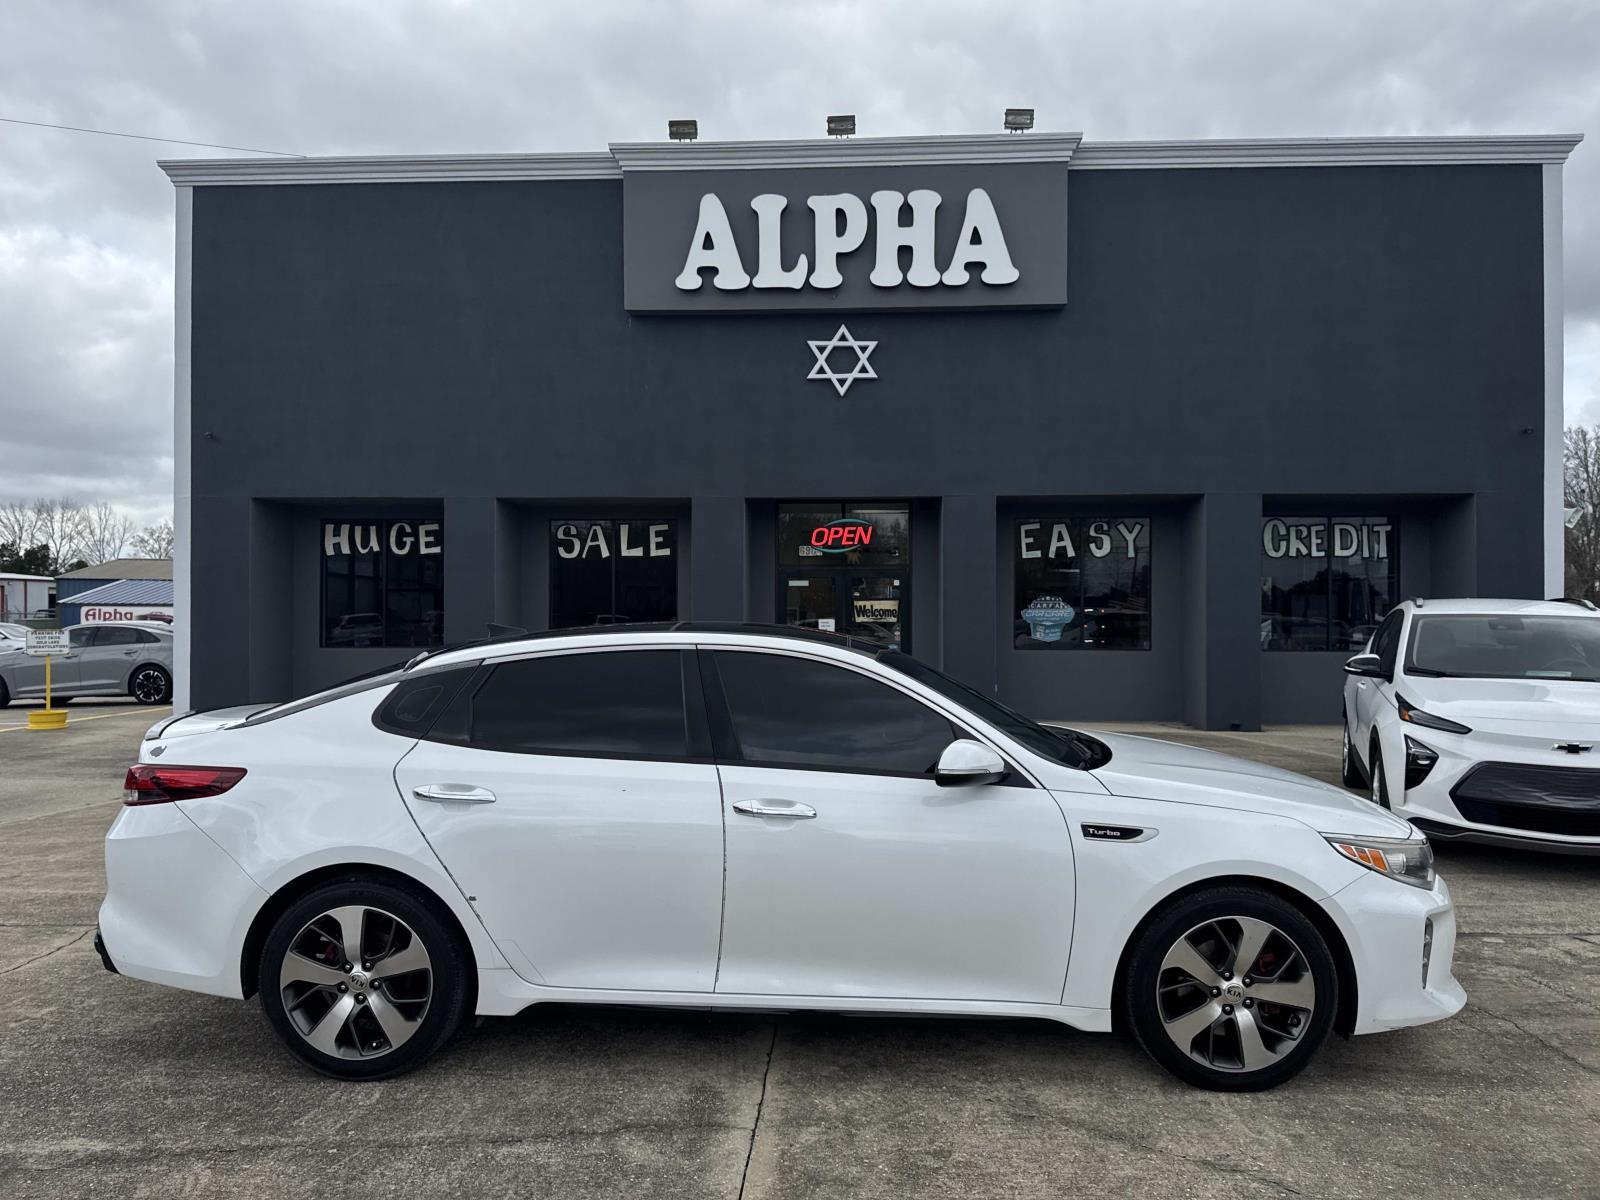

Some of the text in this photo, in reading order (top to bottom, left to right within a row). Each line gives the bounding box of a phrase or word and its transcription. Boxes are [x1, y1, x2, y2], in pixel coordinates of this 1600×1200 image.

[675, 188, 1020, 290] ALPHA
[324, 522, 442, 556] HUGE
[556, 523, 671, 559] SALE
[811, 526, 873, 546] OPEN
[1019, 521, 1144, 559] EASY
[1263, 518, 1393, 558] CREDIT
[85, 608, 133, 621] Alpha
[855, 605, 898, 618] Welcome
[1088, 828, 1120, 836] Turbo
[1227, 986, 1241, 998] KIA
